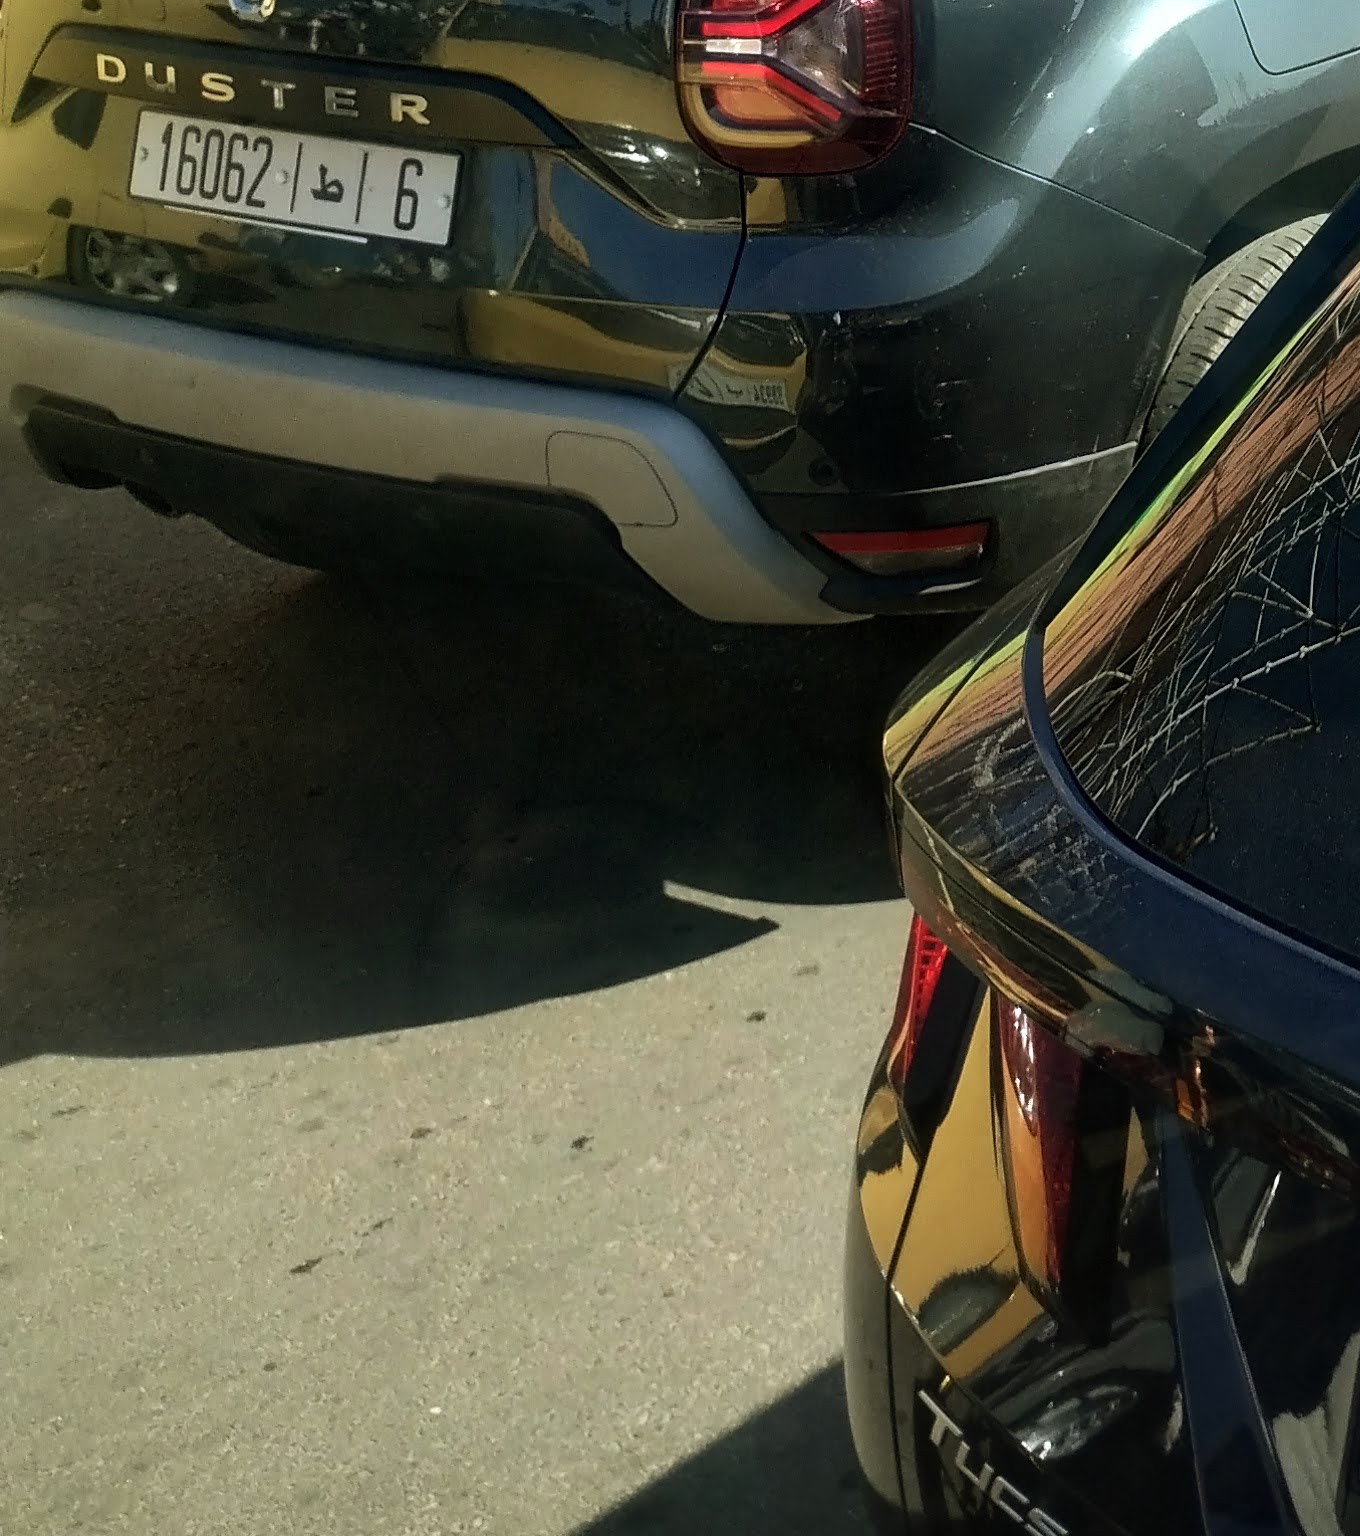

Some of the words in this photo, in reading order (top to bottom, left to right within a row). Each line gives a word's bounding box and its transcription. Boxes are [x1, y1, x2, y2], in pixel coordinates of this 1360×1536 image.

[96, 52, 431, 126] DUSTER
[159, 120, 274, 209] 16062
[393, 157, 424, 231] 6
